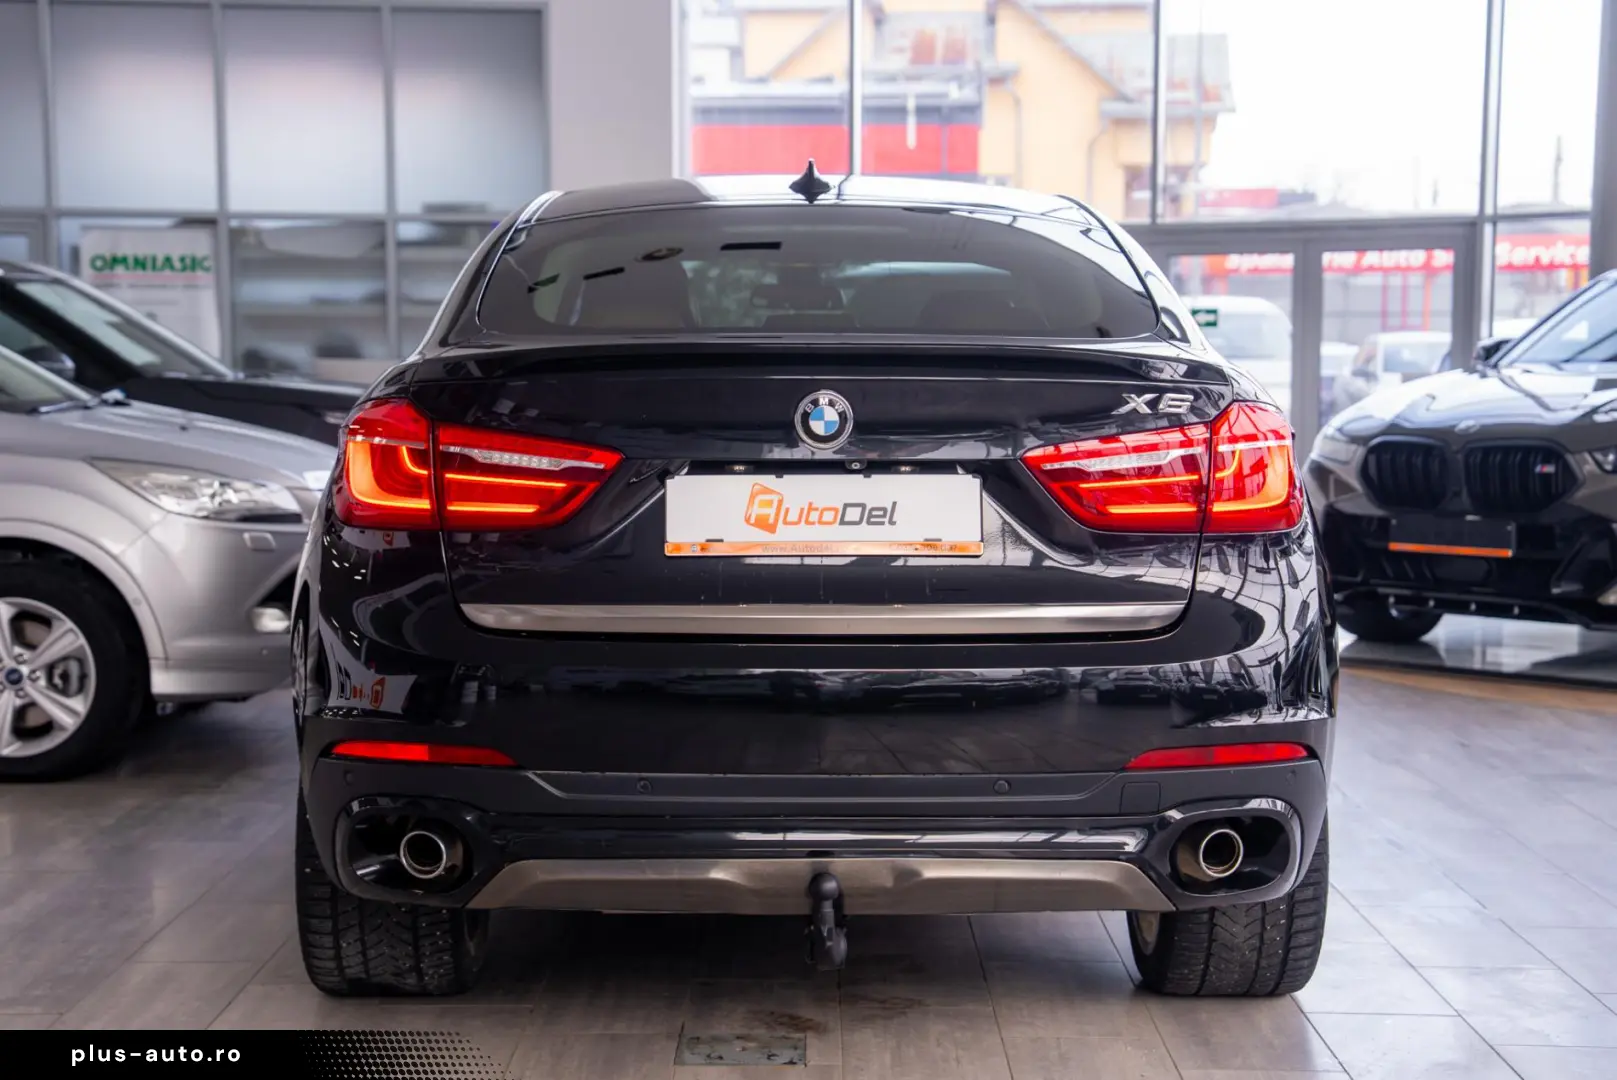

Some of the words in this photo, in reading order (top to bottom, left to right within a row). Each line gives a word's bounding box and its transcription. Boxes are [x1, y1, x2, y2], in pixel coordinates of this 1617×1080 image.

[1495, 240, 1589, 266] Service
[804, 396, 846, 414] BMW
[1110, 392, 1195, 415] X6
[748, 492, 898, 527] AutoDel
